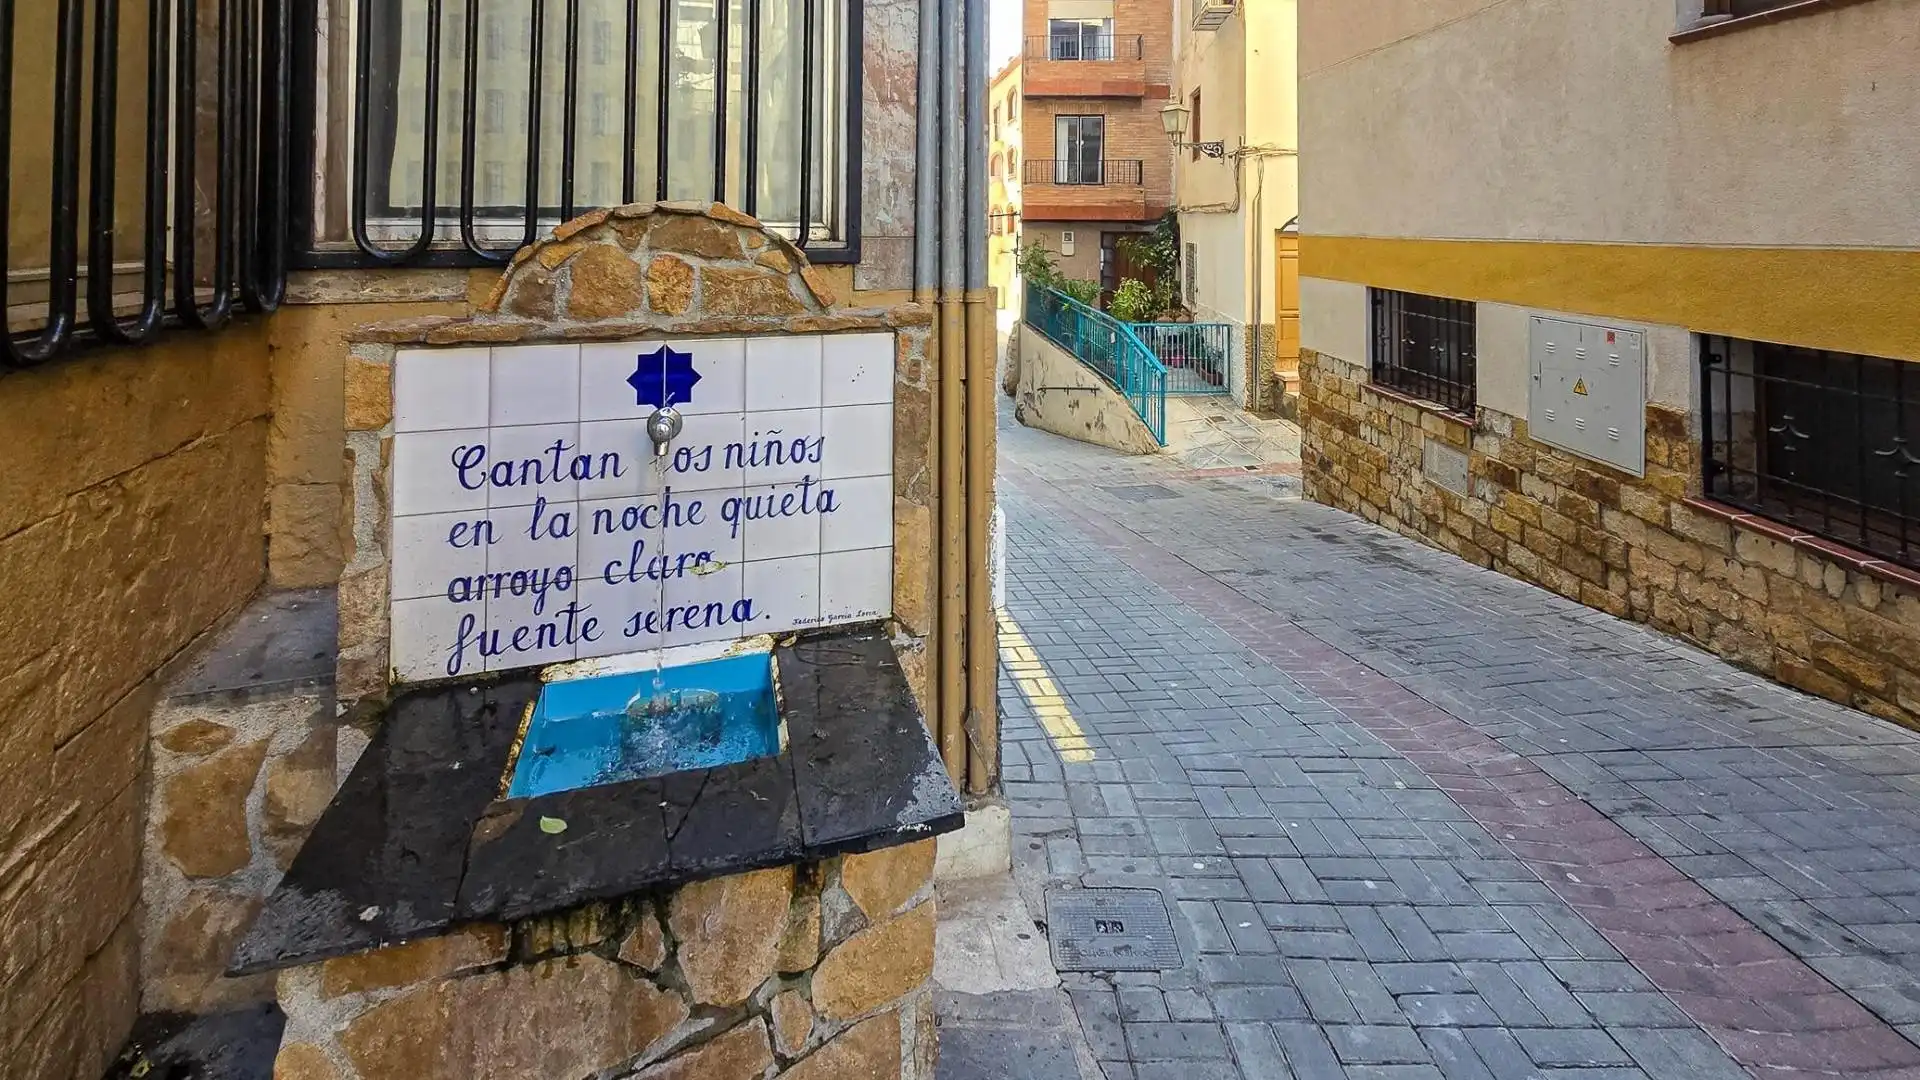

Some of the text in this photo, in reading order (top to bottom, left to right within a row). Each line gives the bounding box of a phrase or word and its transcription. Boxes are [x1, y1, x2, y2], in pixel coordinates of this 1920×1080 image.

[452, 429, 825, 490] Cantan os niños
[446, 475, 841, 548] en la noche quieta
[448, 565, 575, 616] arroyo
[446, 598, 771, 676] fuente serena.
